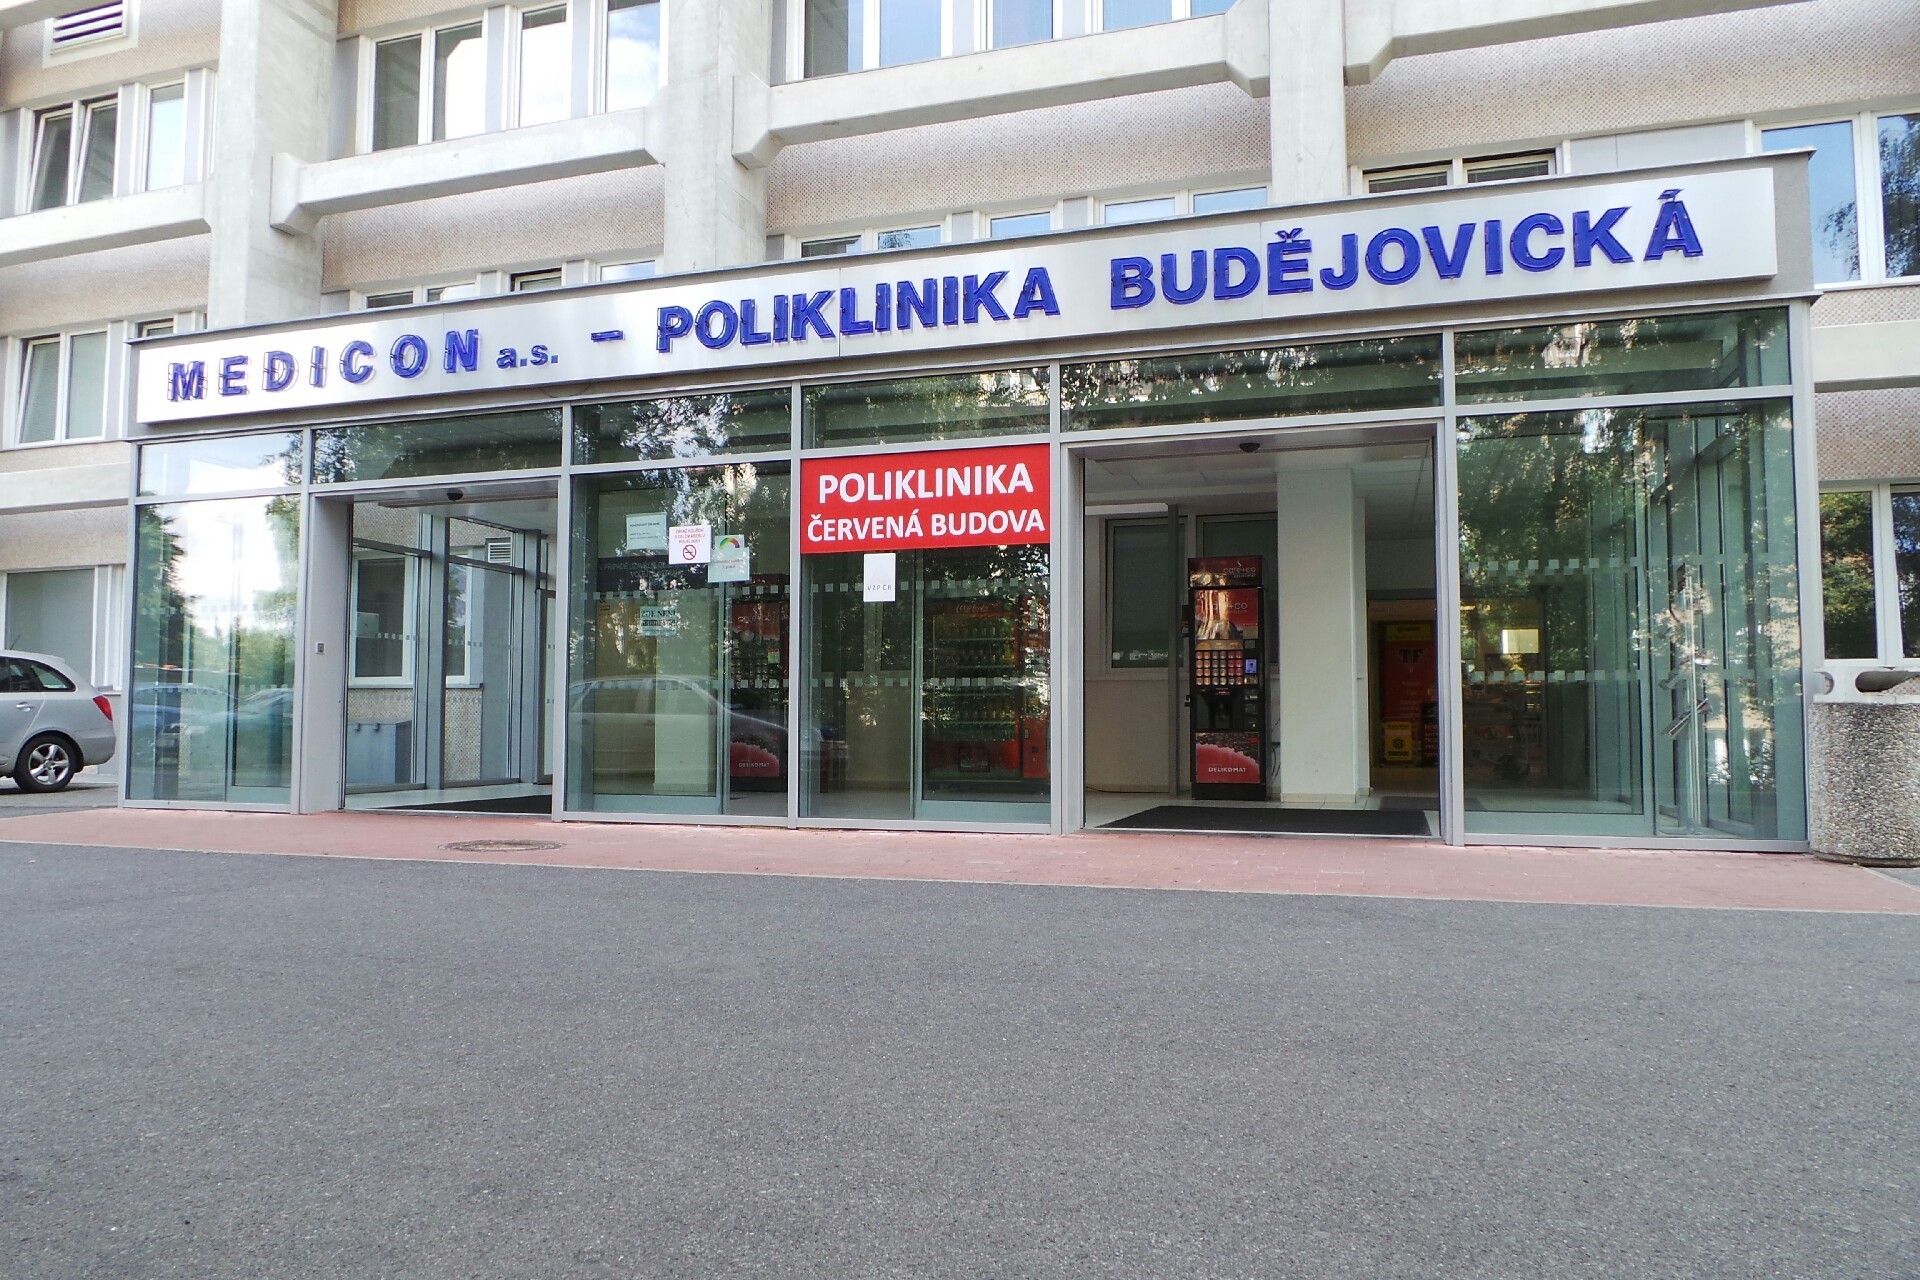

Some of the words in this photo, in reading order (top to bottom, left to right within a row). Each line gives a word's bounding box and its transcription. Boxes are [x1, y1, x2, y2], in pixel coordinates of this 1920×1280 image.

[167, 327, 479, 401] MEDICON
[497, 340, 559, 368] a.s.
[656, 267, 1060, 353] POLIKLINIKA
[1110, 189, 1703, 310] BUDĚJOVICKÁ
[819, 462, 1034, 504] POLIKLINIKA
[807, 508, 924, 542] ČERVENÁ
[931, 509, 1046, 536] BUDOVA
